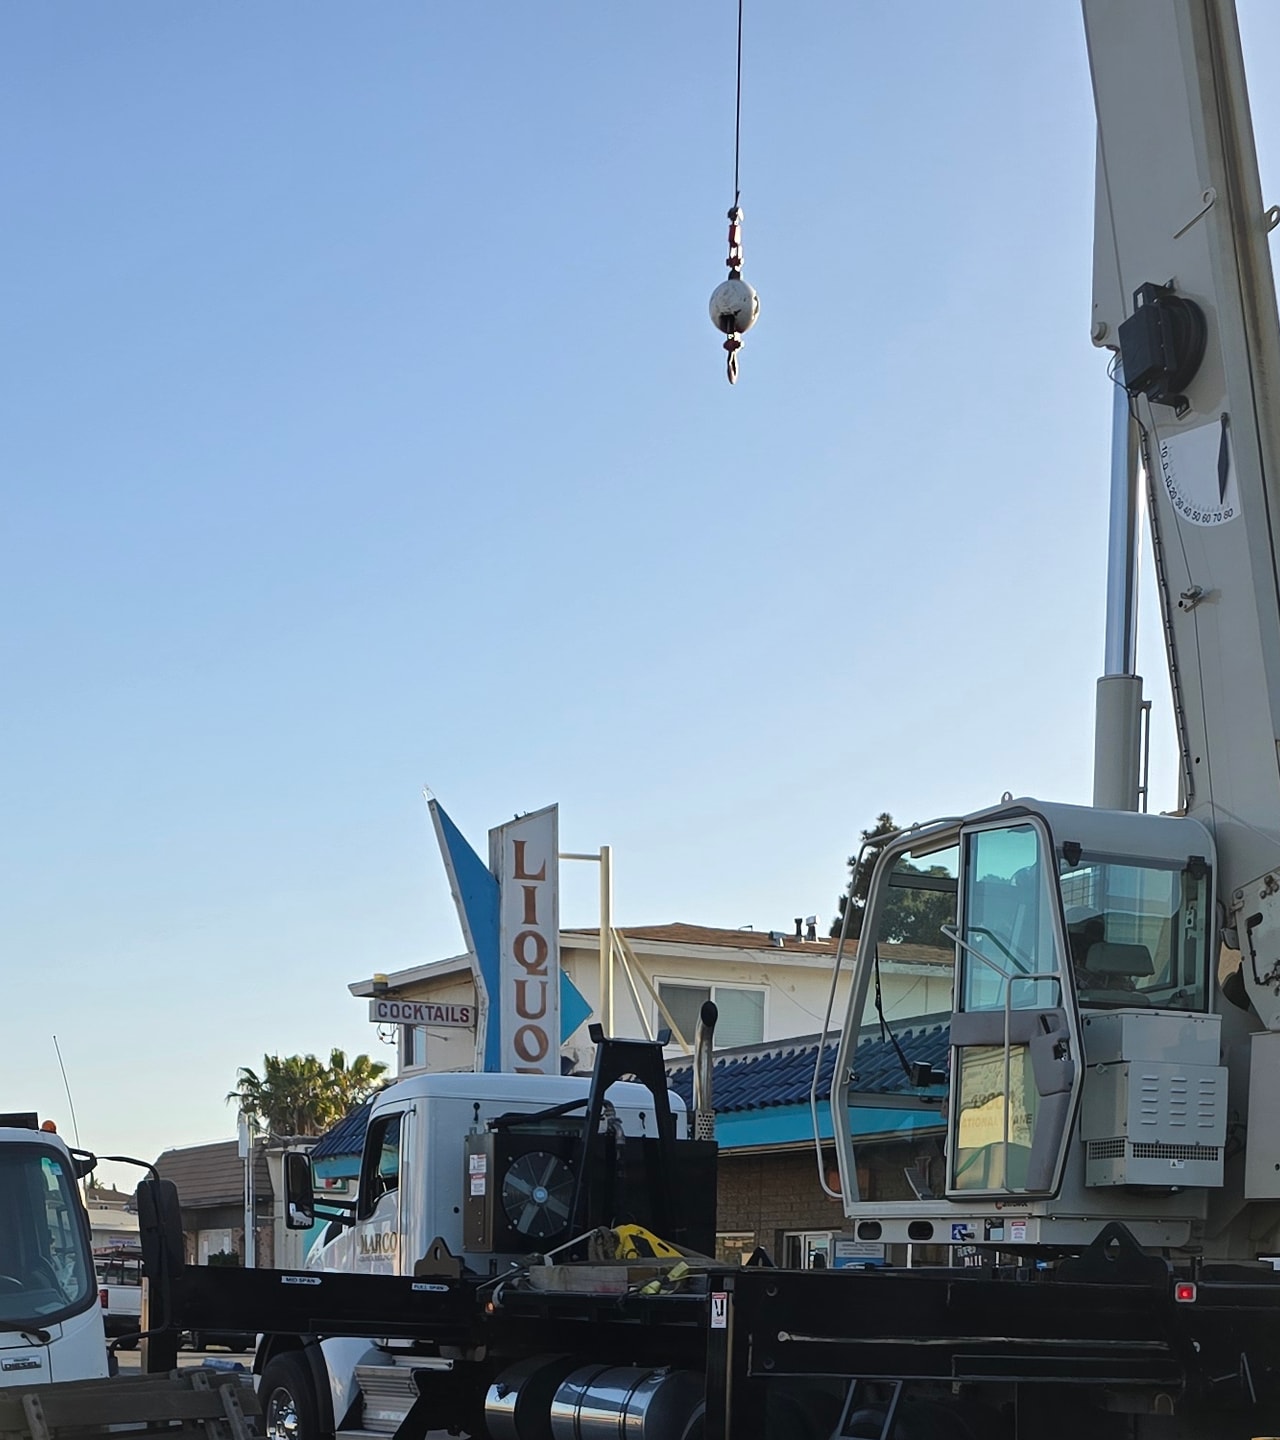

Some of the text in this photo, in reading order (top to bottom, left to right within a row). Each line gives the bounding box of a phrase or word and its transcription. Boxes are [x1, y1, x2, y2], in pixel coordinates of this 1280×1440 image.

[1165, 475, 1173, 489] 10
[1169, 487, 1177, 500] 20
[1175, 497, 1184, 509] 30
[1183, 505, 1192, 516] 40
[1191, 511, 1201, 522] 50
[1201, 513, 1211, 523] 60
[1212, 512, 1222, 523] 70
[1223, 508, 1234, 519] 80
[512, 839, 549, 1074] LIQUO
[377, 1002, 470, 1023] COCKTAILS
[360, 1232, 400, 1255] MARCO
